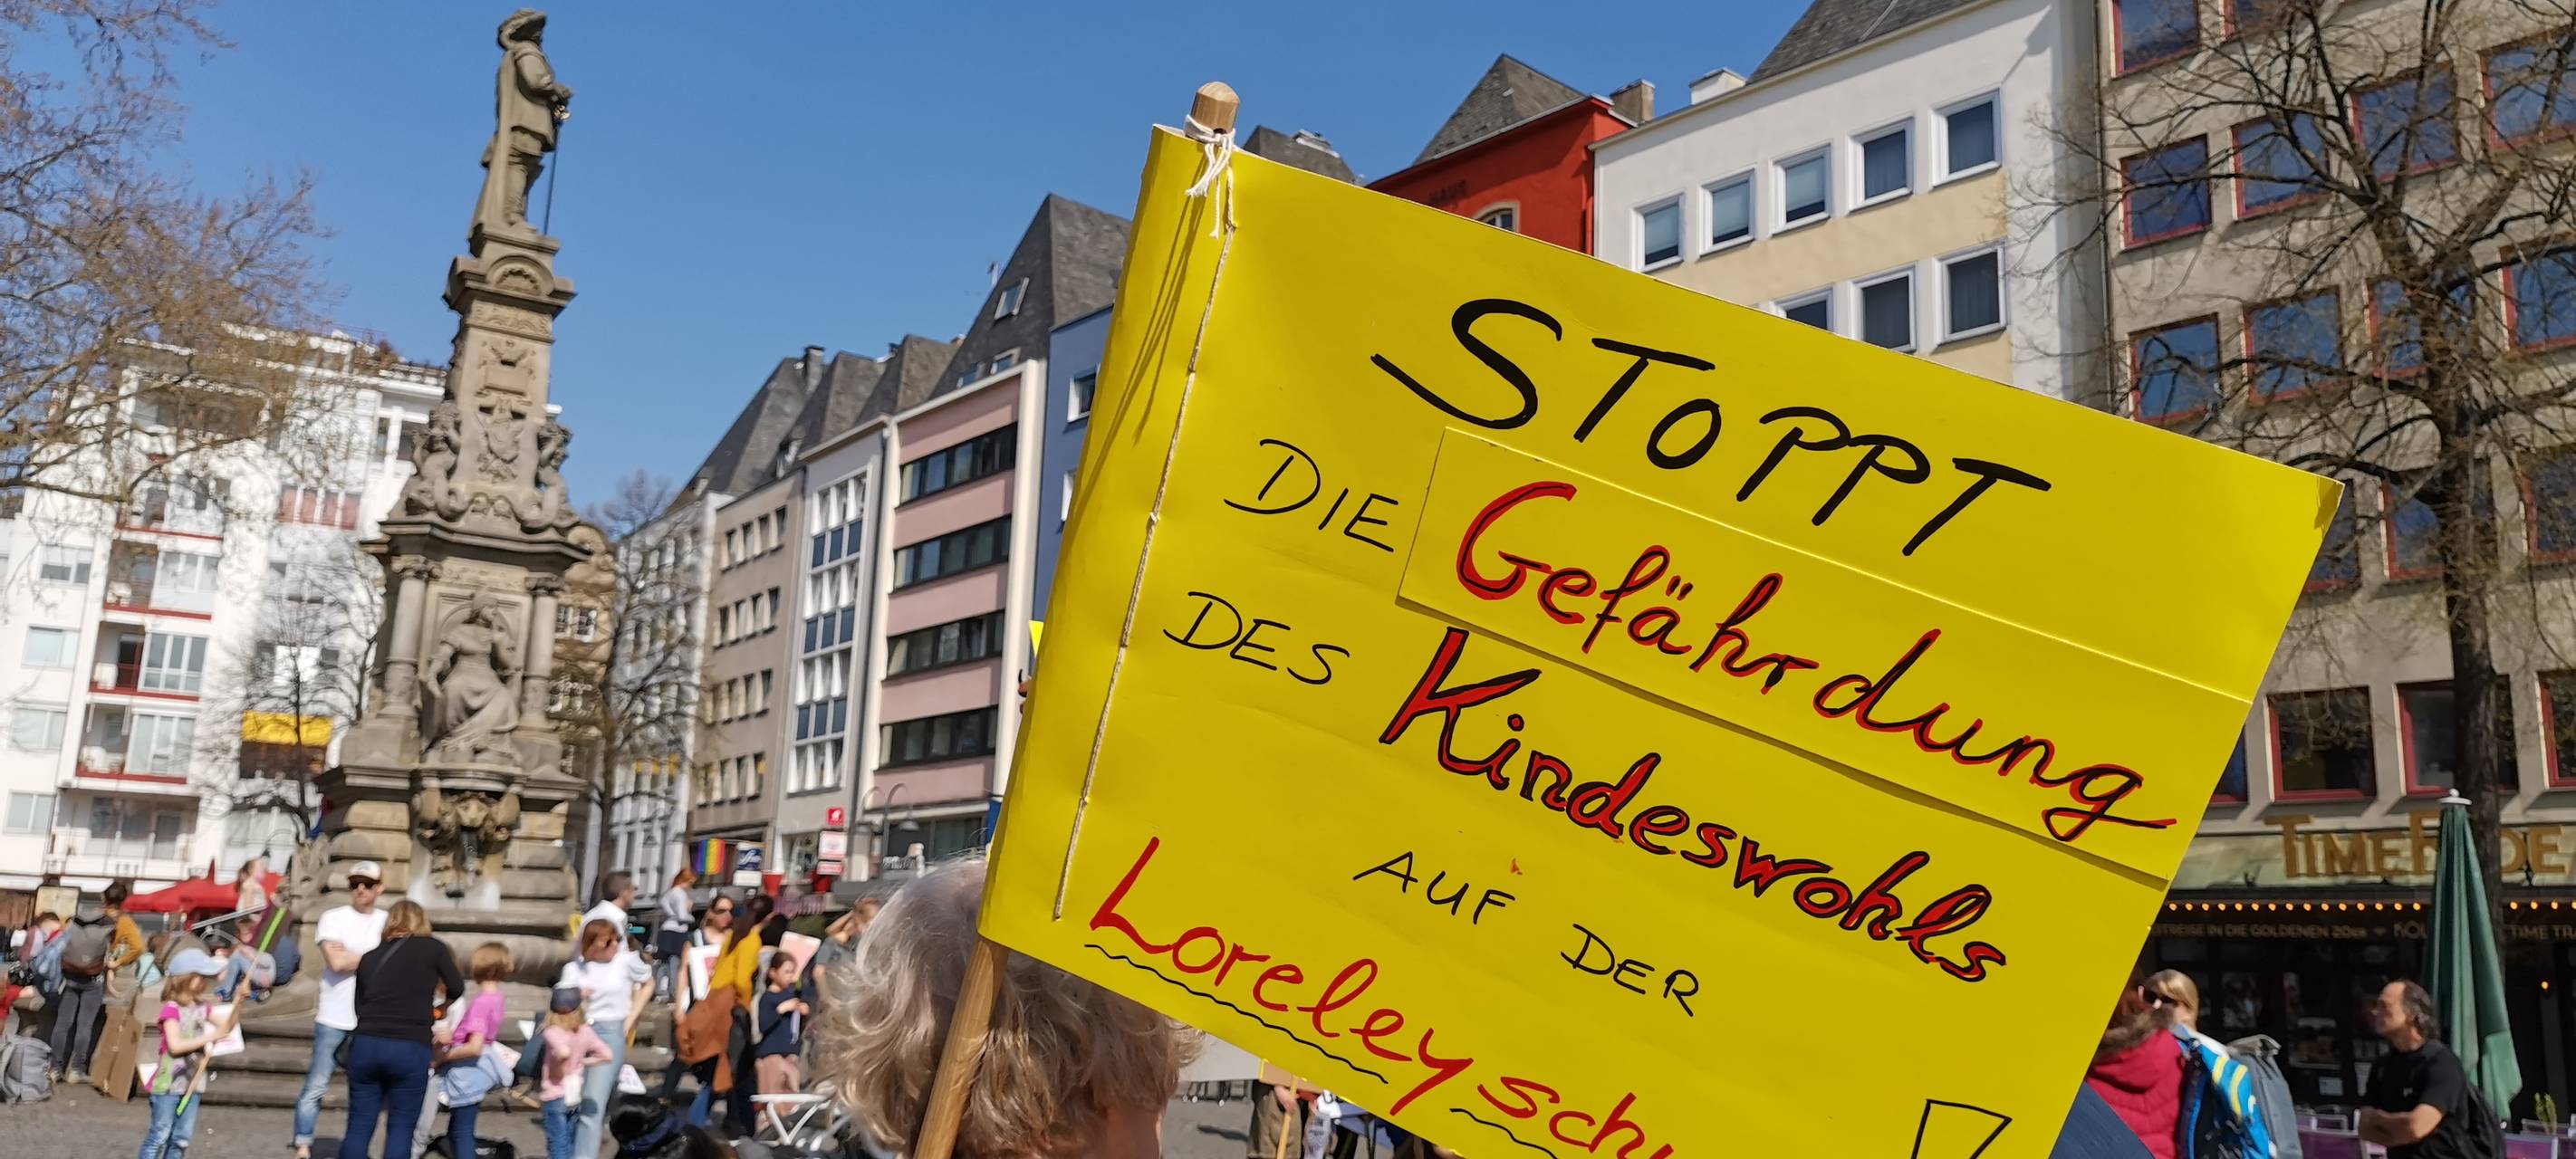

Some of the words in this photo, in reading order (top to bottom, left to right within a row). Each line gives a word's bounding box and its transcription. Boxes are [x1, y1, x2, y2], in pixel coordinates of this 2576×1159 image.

[1370, 299, 2051, 556] STOPPT
[1163, 592, 1350, 685] DES
[1379, 627, 2005, 982] Kindeswohls
[1224, 439, 1399, 552] DIE
[1456, 482, 2177, 841] Gefährdung
[1090, 838, 1673, 1159] Loreleysch
[1353, 852, 1515, 924] AUF
[1561, 924, 1698, 1017] DER
